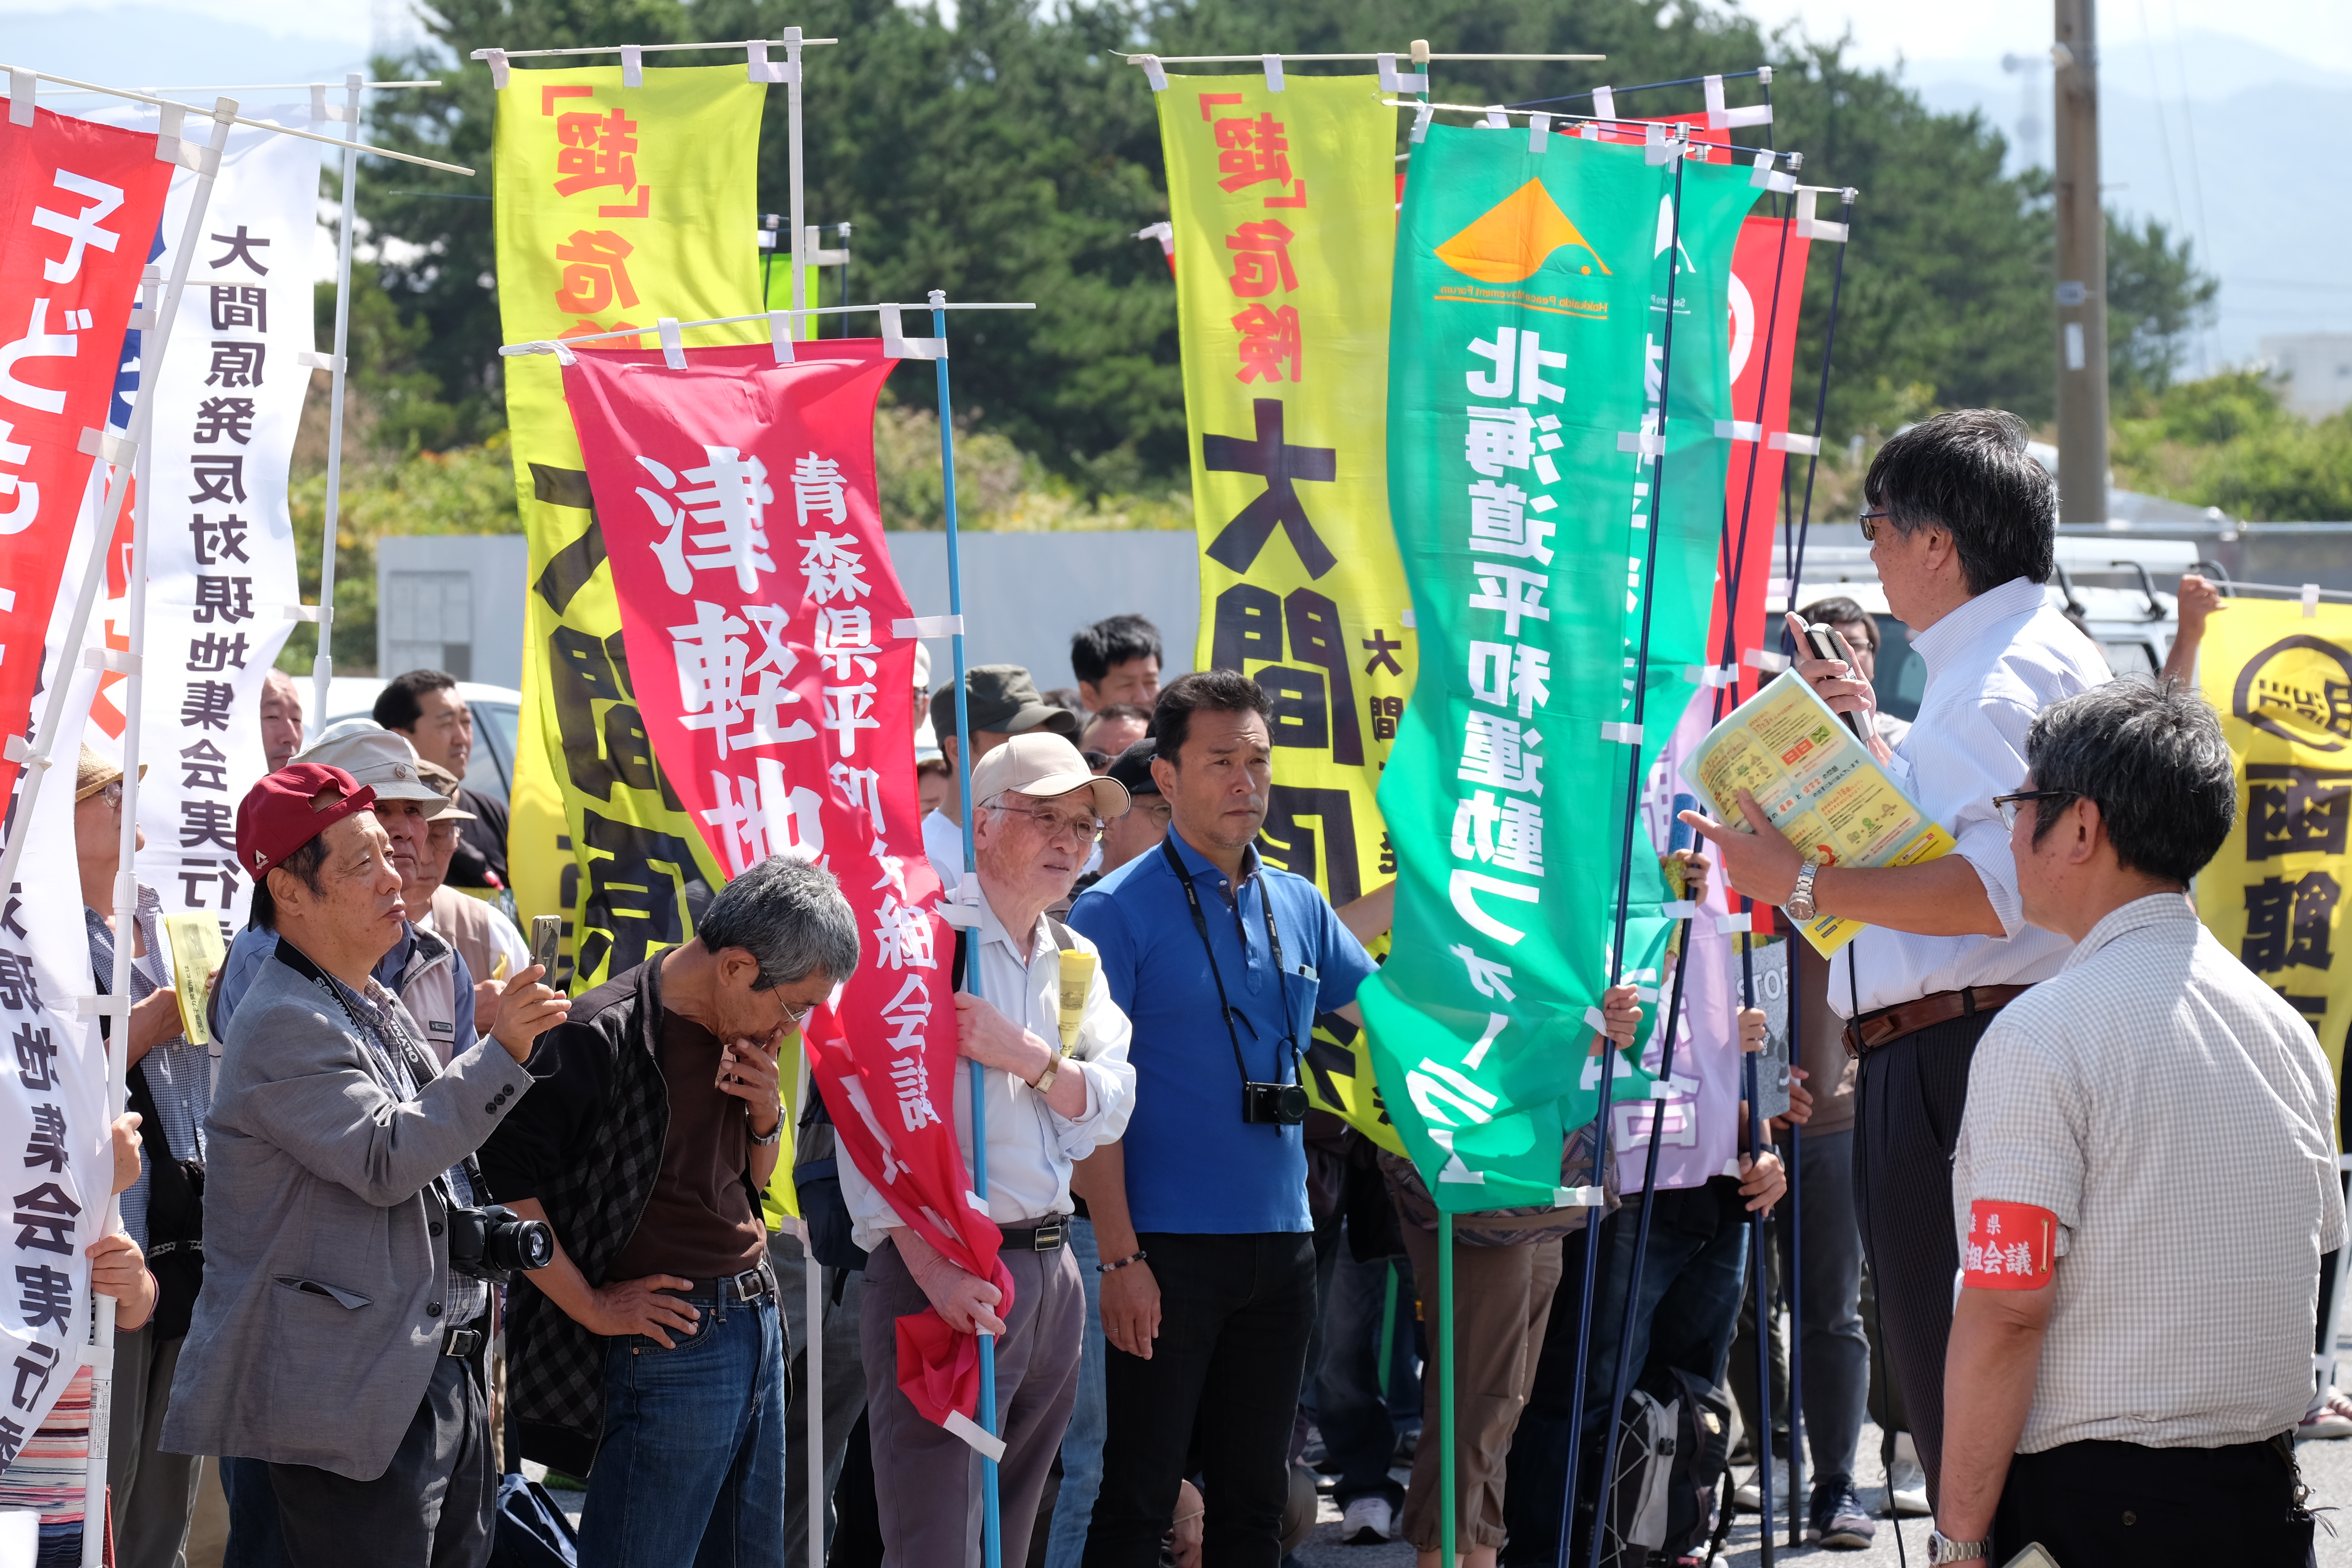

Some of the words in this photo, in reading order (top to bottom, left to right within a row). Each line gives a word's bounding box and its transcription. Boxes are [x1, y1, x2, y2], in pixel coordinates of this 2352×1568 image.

[184, 965, 206, 1034] 大間原子力発電所とは
